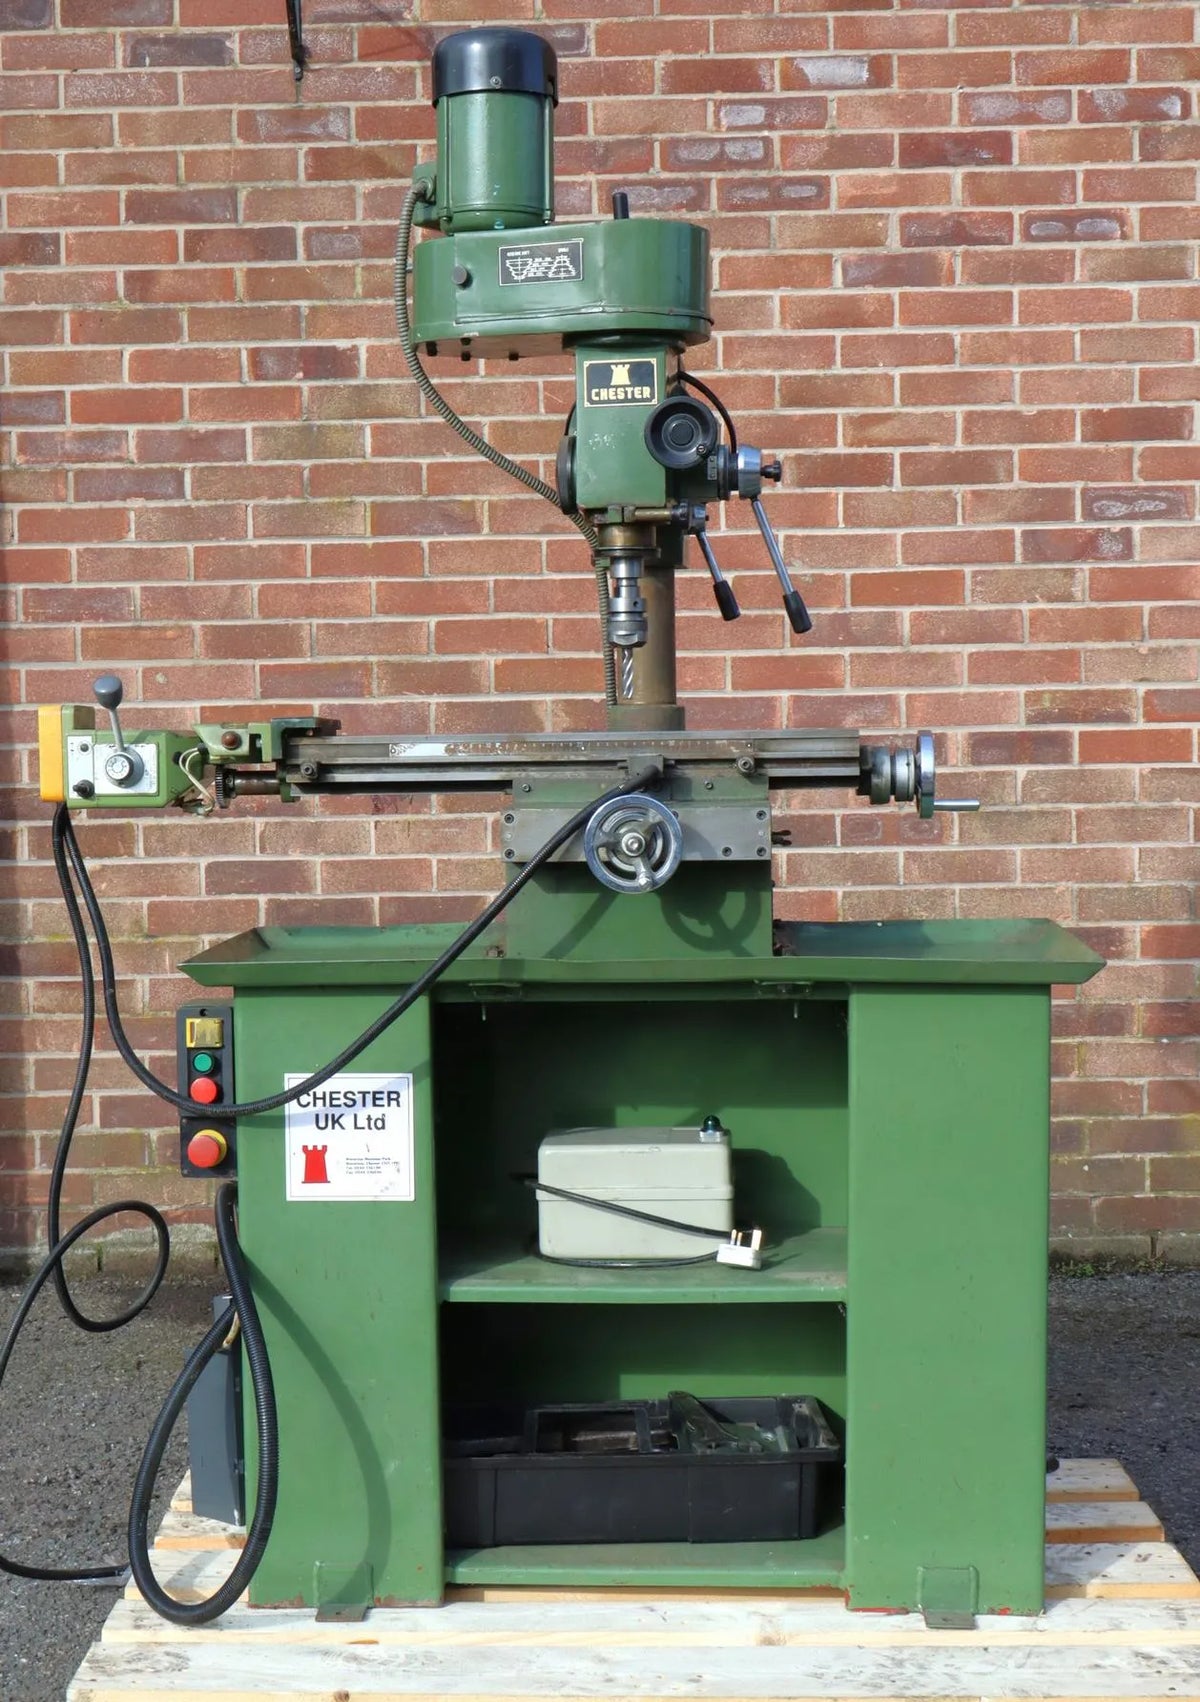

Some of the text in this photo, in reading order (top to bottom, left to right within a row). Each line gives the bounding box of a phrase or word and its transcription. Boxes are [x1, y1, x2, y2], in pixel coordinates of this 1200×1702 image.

[591, 386, 651, 401] CHESTER
[297, 1091, 401, 1108] CHESTER
[315, 1113, 386, 1130] UK Ltd
